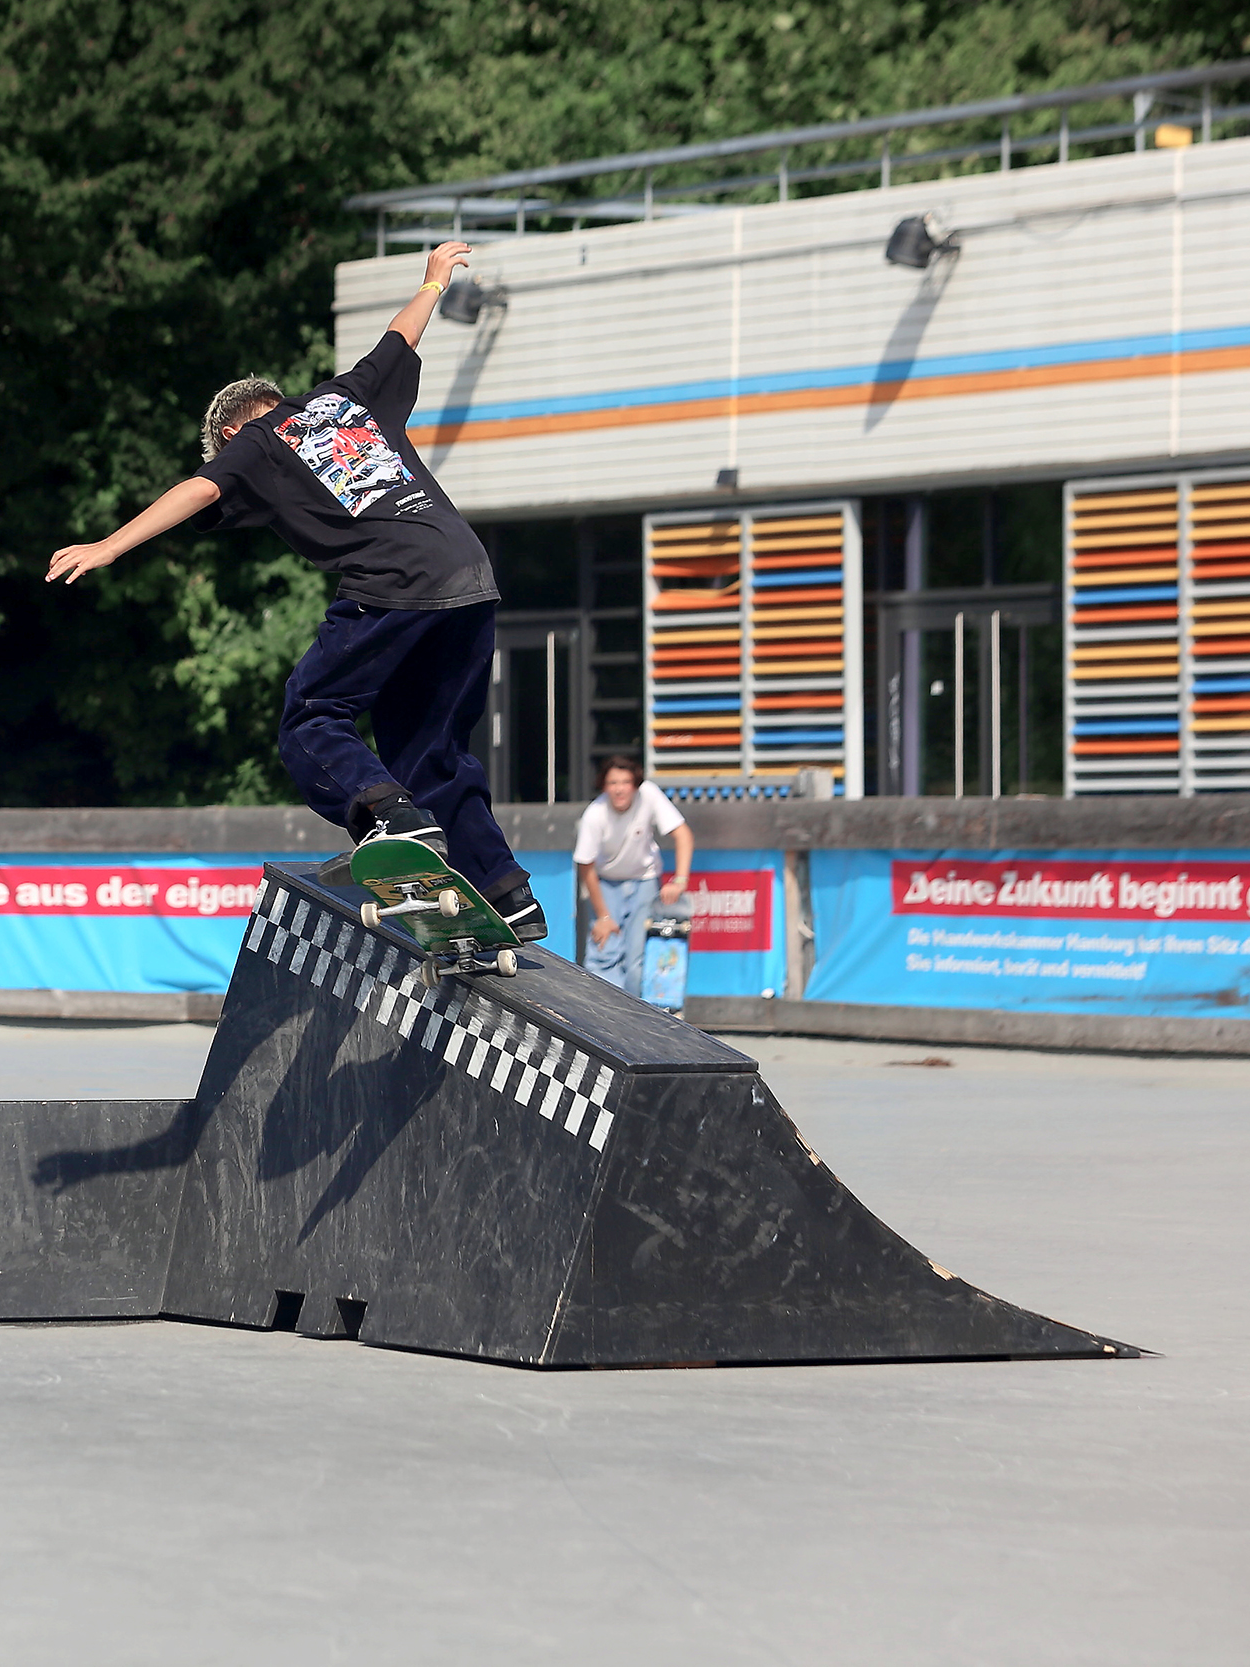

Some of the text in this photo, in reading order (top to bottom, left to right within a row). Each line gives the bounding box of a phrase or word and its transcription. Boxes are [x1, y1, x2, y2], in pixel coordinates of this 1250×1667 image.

[15, 882, 88, 907] aus
[96, 876, 159, 907] der
[165, 877, 258, 915] eigen
[903, 870, 997, 905] Deine
[997, 870, 1114, 908] Zukunft
[1118, 871, 1244, 918] beginnt
